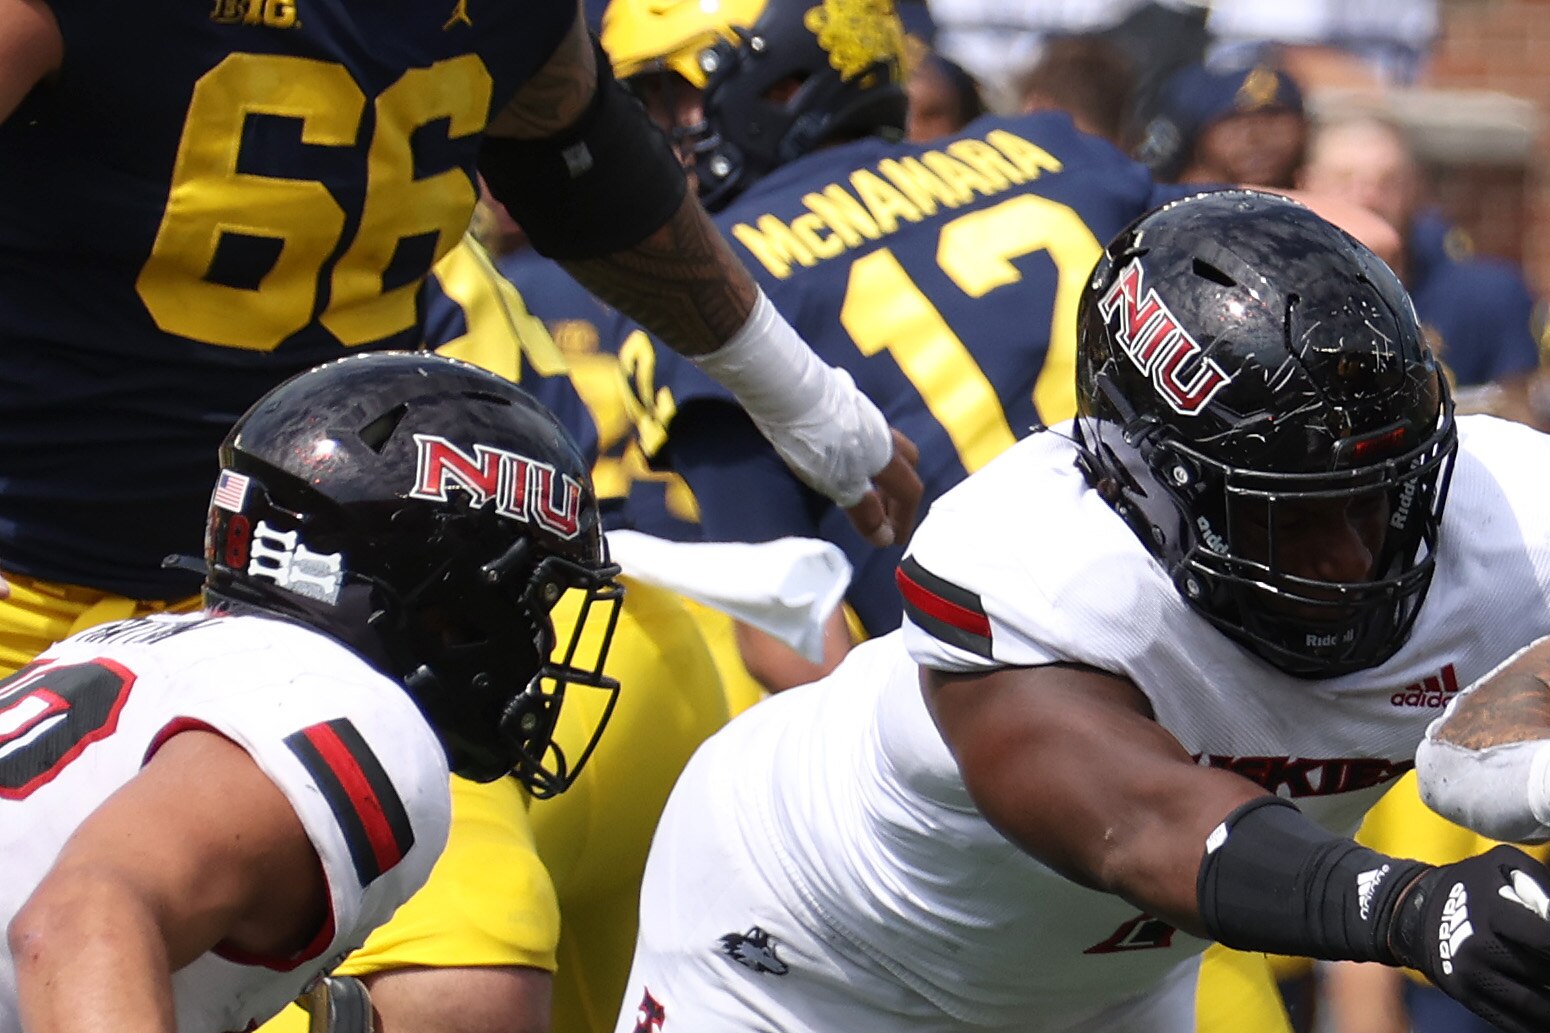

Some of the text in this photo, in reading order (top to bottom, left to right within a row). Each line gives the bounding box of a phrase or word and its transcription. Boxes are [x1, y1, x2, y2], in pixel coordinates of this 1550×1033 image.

[135, 52, 494, 351] 66
[732, 128, 1065, 281] McNAMARA
[839, 192, 1106, 476] 12
[1098, 256, 1232, 416] NIU
[409, 433, 583, 542] NIU
